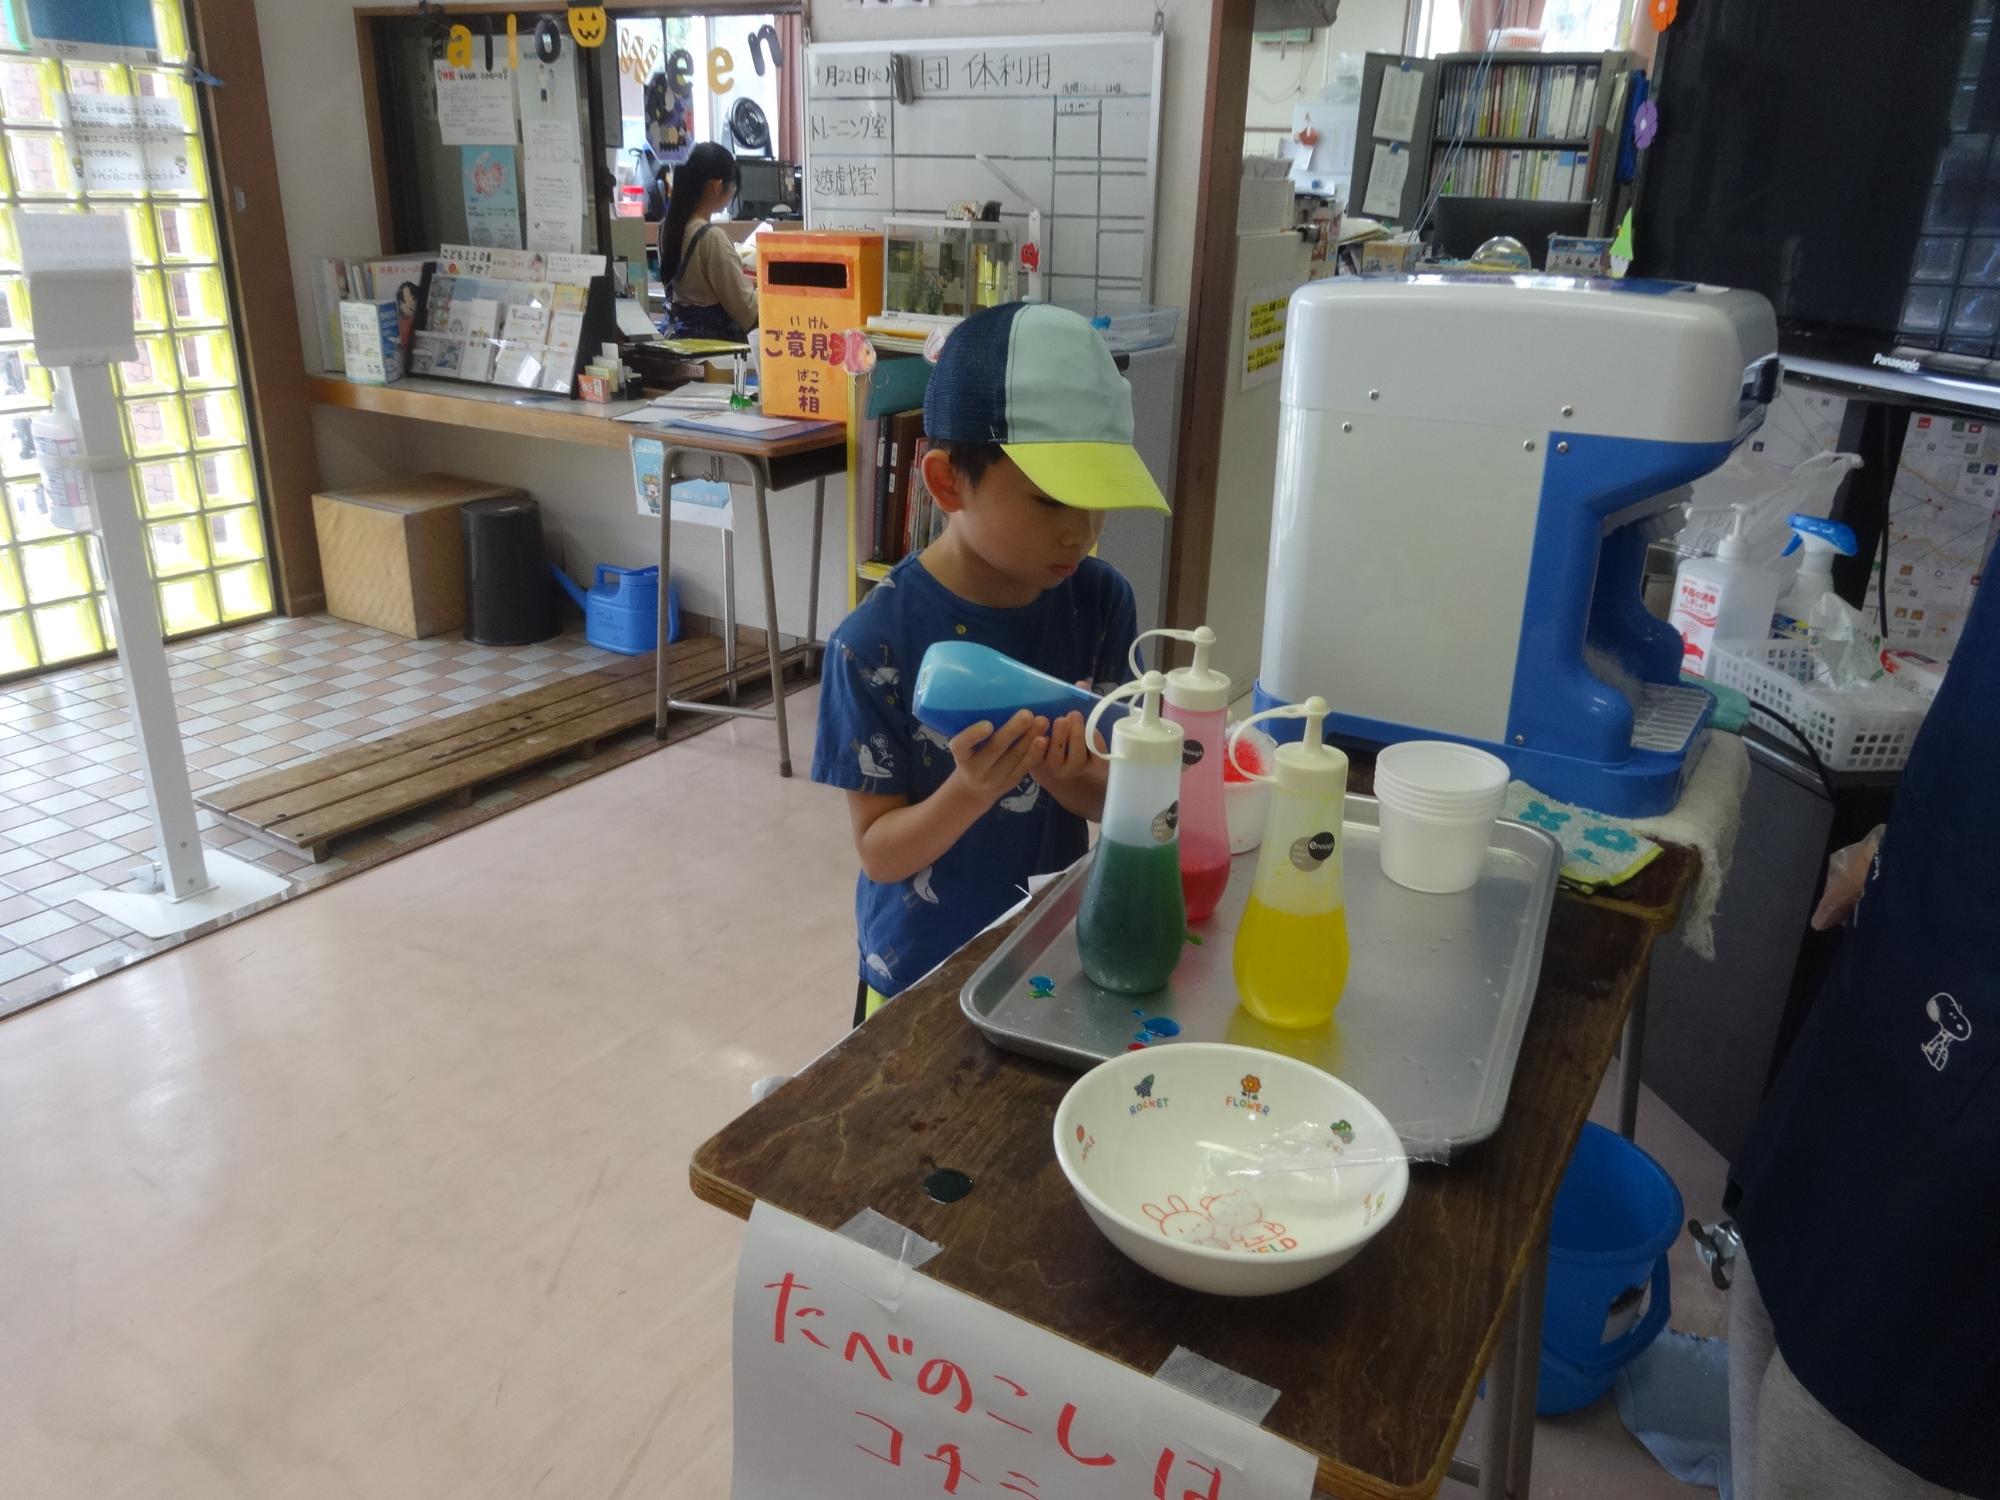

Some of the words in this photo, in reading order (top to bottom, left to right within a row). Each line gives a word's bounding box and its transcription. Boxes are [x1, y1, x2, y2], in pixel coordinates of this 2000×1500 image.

[811, 112, 888, 141] トレーニング室
[814, 163, 879, 197] 遊戯室
[765, 329, 830, 363] ご意見
[1872, 352, 1920, 371] Panasonic
[797, 369, 819, 383] ばこ
[798, 386, 820, 414] 箱
[1129, 1097, 1169, 1116] ROCKET
[1225, 1096, 1270, 1116] FLOWER
